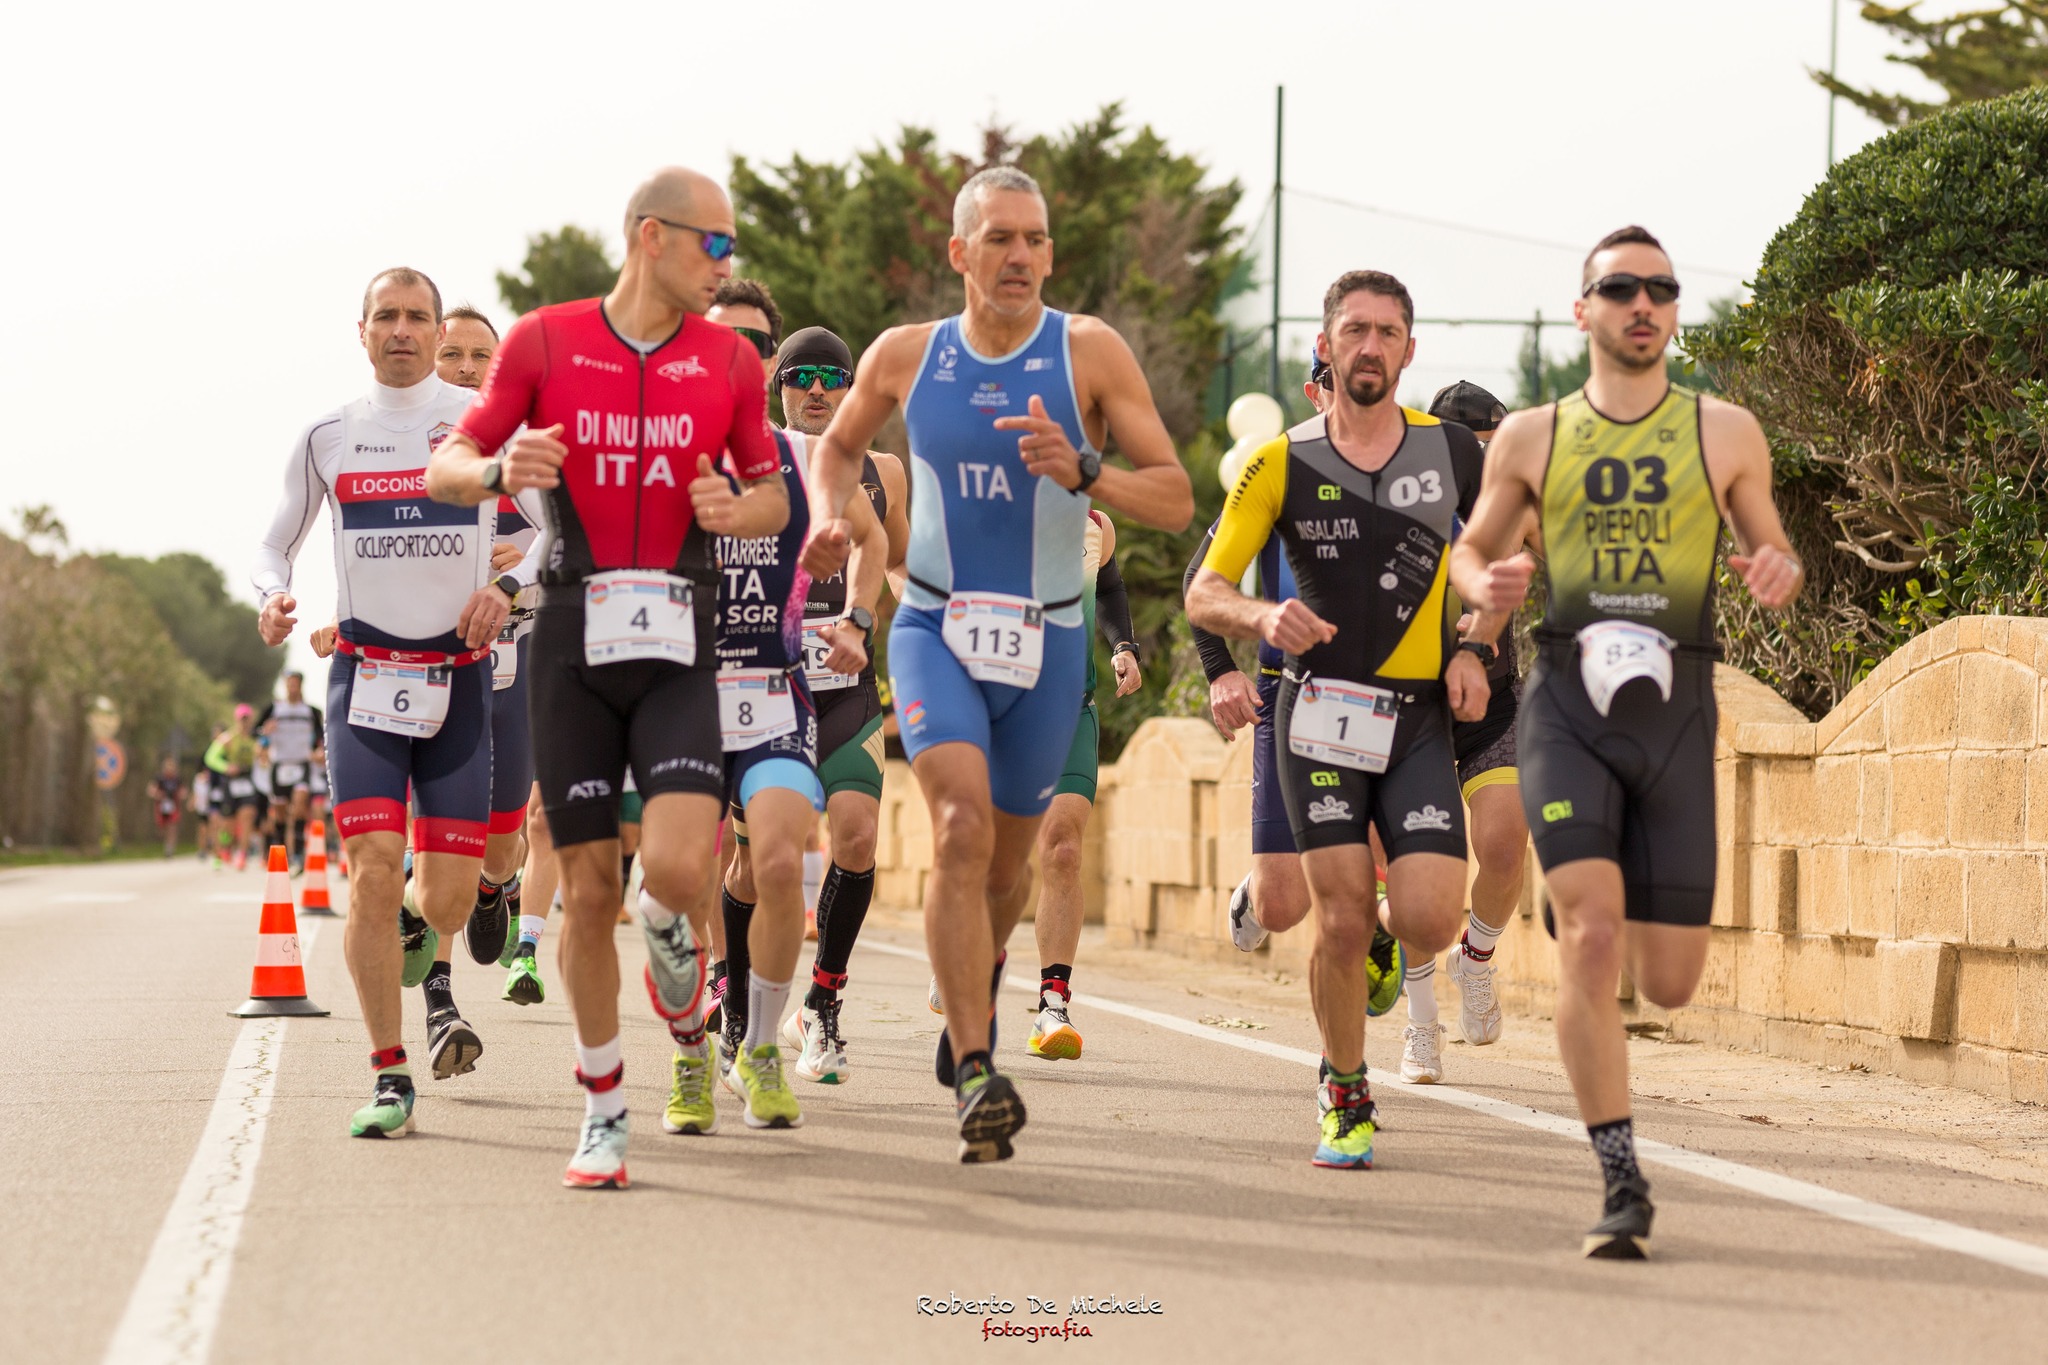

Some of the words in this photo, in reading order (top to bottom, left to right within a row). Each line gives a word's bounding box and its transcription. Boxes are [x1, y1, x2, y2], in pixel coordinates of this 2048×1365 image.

[585, 358, 623, 374] PISSEI
[577, 411, 599, 445] DI
[605, 412, 694, 448] NUNNO
[364, 445, 396, 454] PISSEI
[595, 453, 676, 489] ITA
[957, 461, 1014, 502] ITA
[1585, 454, 1671, 506] 03
[1388, 469, 1444, 508] 03
[394, 506, 423, 520] ITA
[1295, 518, 1360, 541] INSALATA
[1585, 508, 1671, 546] PIEPOLI
[355, 533, 465, 559] CICLISPORT2000
[1316, 544, 1340, 559] ITA
[1590, 547, 1665, 585] ITA
[716, 567, 766, 601] TA
[630, 605, 650, 632] 4
[726, 604, 779, 625] SGR
[725, 625, 750, 635] LUCE
[759, 624, 777, 633] GAS
[967, 625, 1022, 657] 113
[1606, 643, 1645, 666] 82
[393, 689, 410, 713] 6
[738, 701, 754, 727] 8
[1337, 715, 1350, 741] 1
[566, 780, 612, 802] ATS
[353, 812, 390, 824] PISSEI
